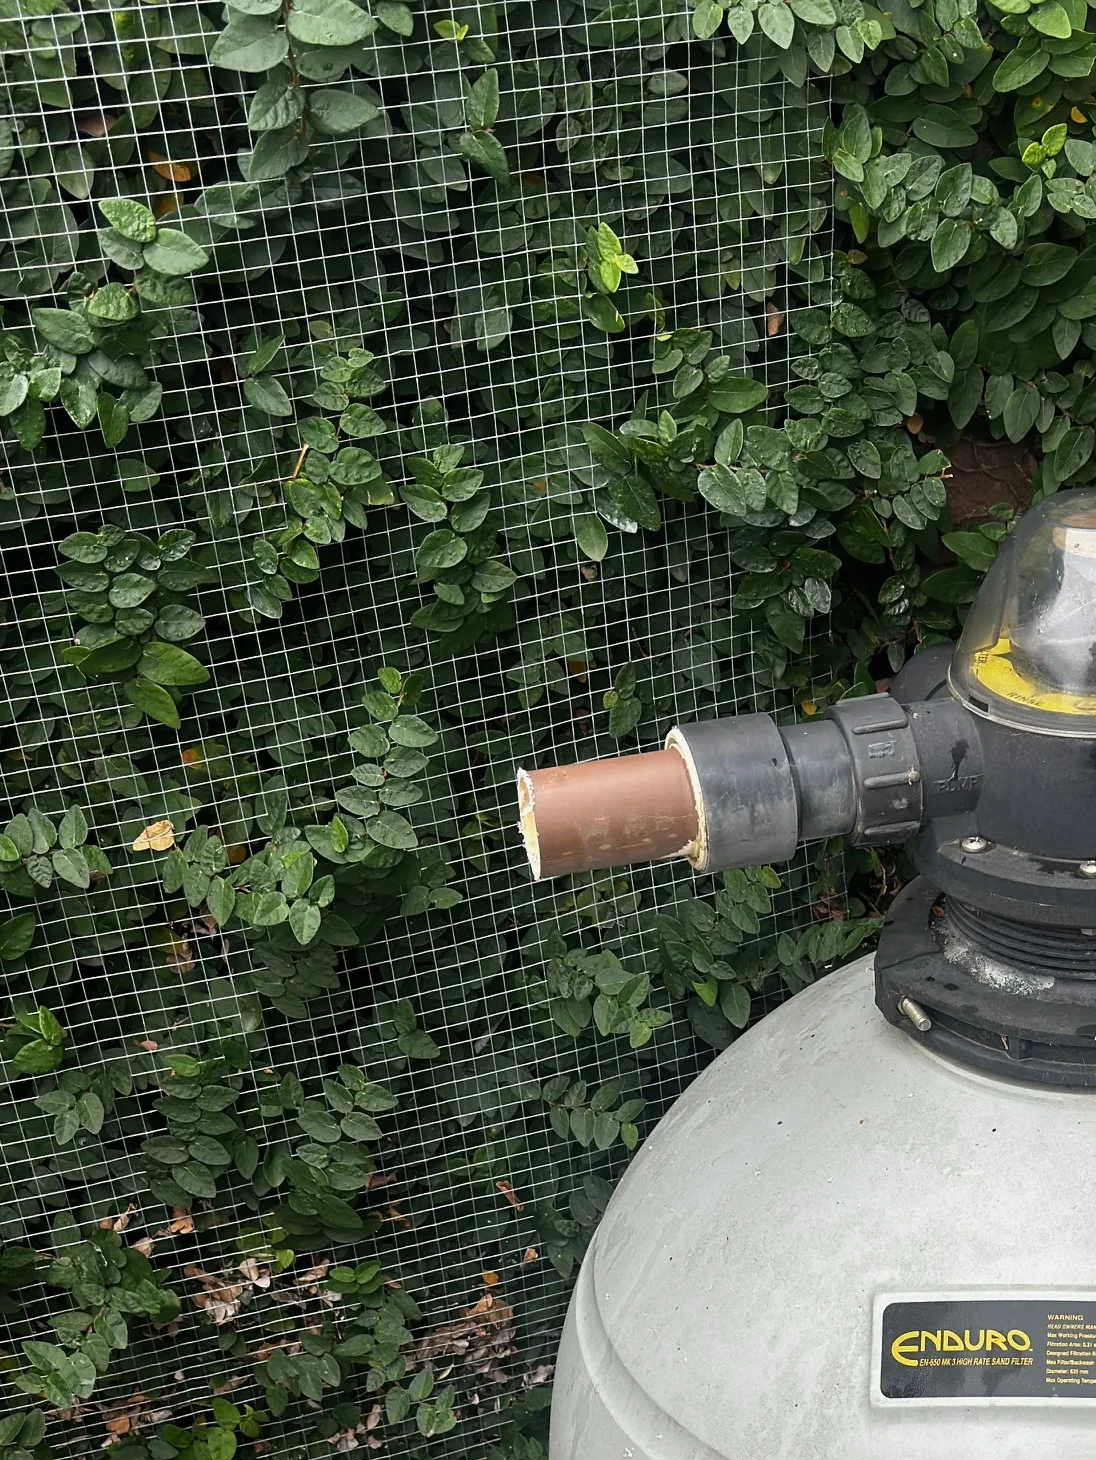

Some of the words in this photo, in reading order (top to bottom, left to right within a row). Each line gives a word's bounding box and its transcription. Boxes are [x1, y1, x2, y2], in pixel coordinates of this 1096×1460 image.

[891, 1329, 1031, 1367] ENDURO
[956, 1357, 973, 1366] HIGH
[973, 1357, 991, 1366] RATE
[991, 1357, 1010, 1366] SAND
[1010, 1357, 1034, 1366] FILTER
